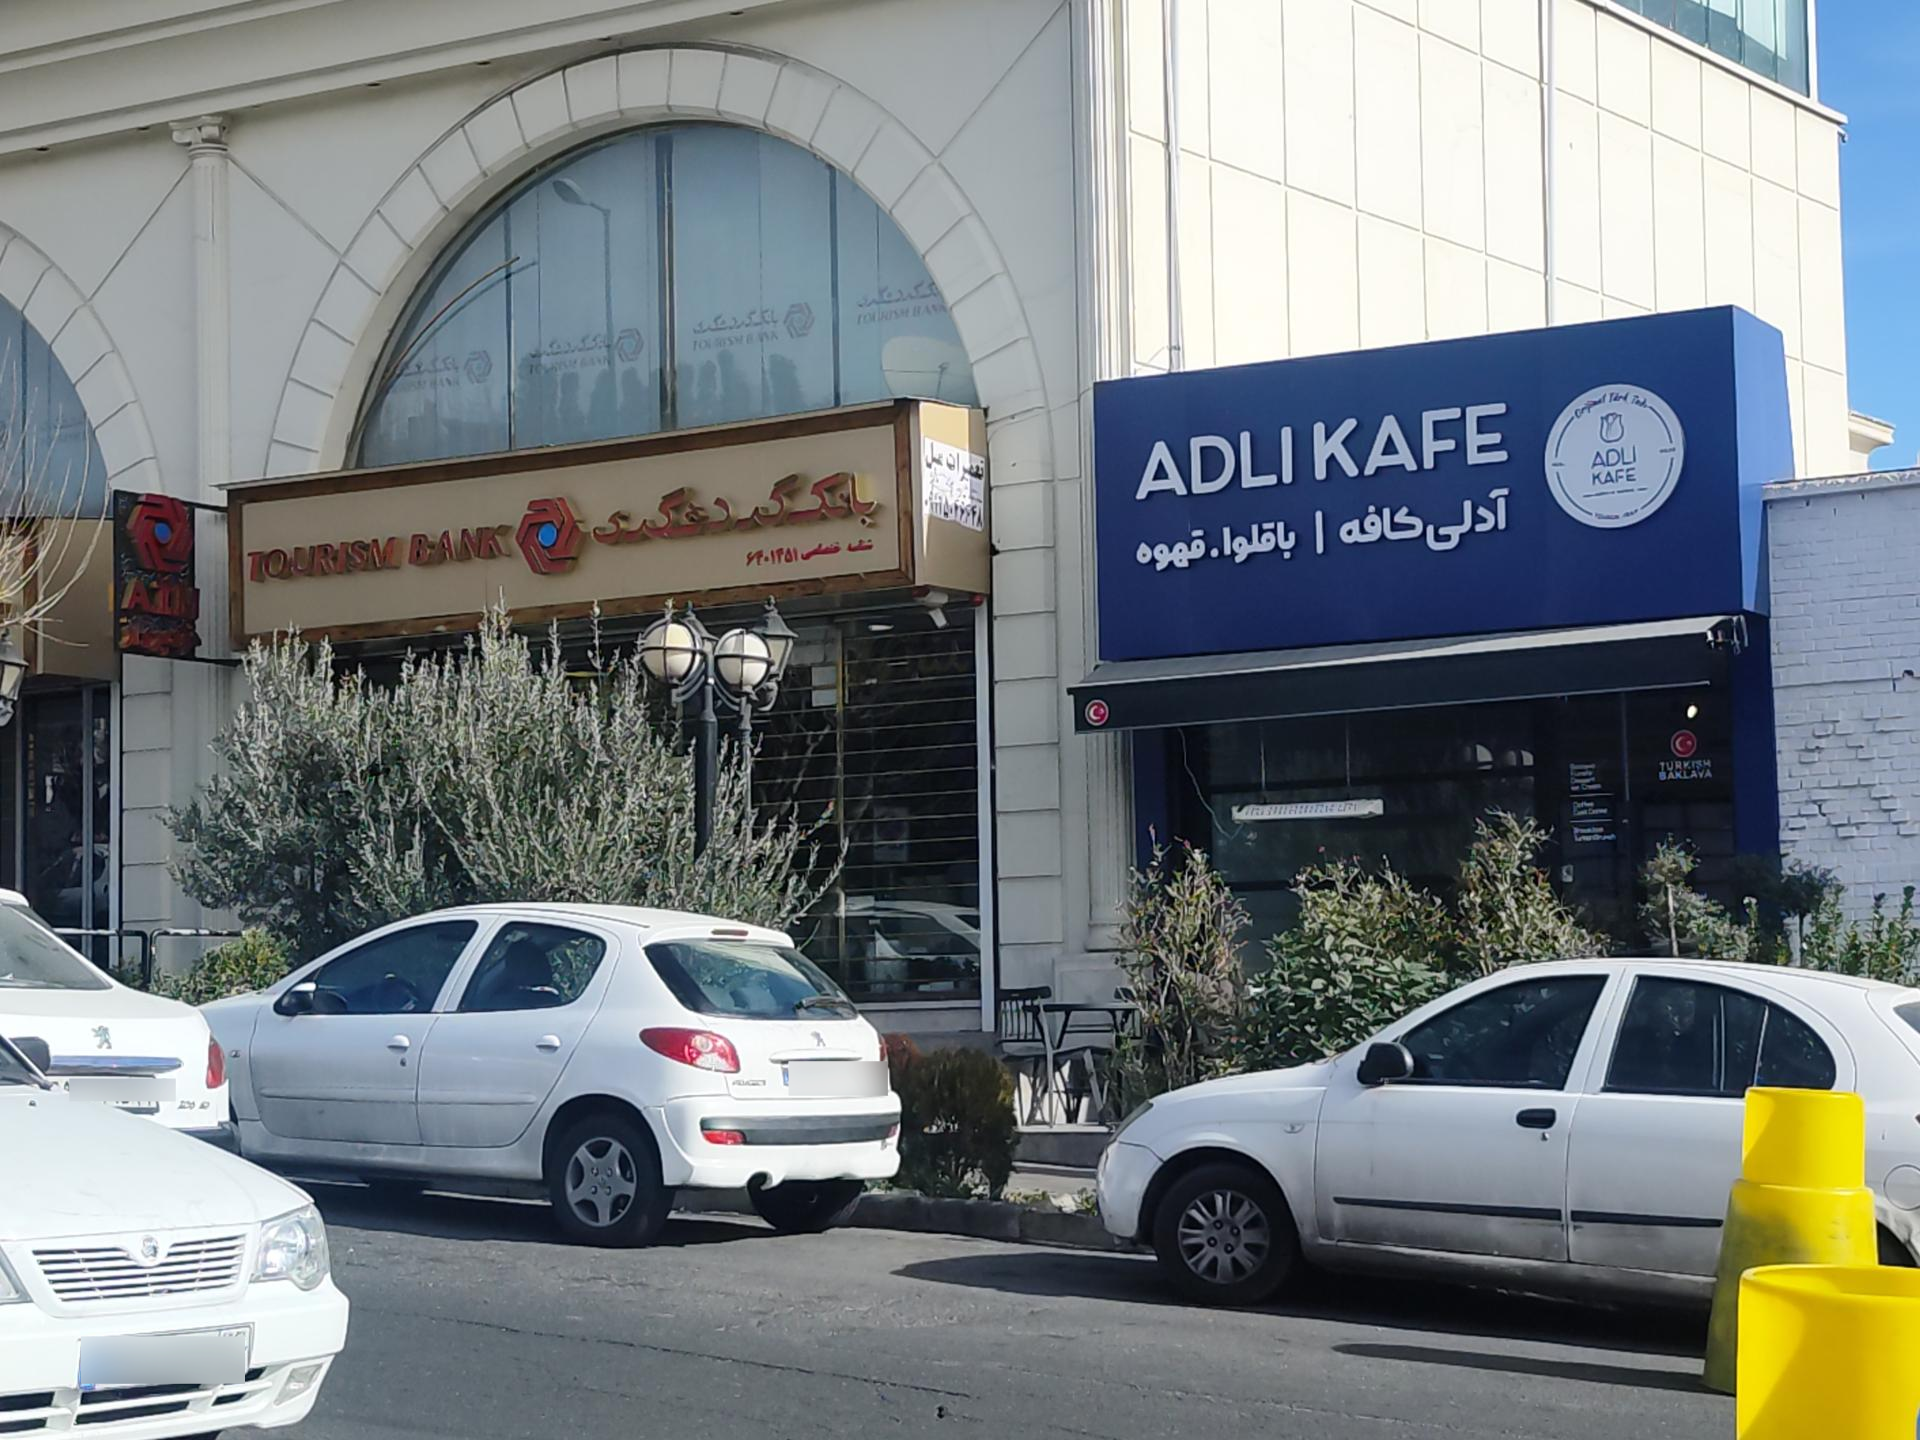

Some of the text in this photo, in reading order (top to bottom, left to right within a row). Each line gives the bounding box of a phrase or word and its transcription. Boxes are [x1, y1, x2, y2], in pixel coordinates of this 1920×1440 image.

[1136, 402, 1509, 500] ADLI KAFE
[1591, 445, 1637, 469] ADLI
[1592, 467, 1637, 486] KAFE
[591, 474, 800, 546] گردشگری
[789, 471, 878, 528] بانک
[248, 524, 513, 583] TOURISM BANK
[1658, 758, 1712, 771] TURKISH
[1658, 768, 1713, 781] BAKLAVA
